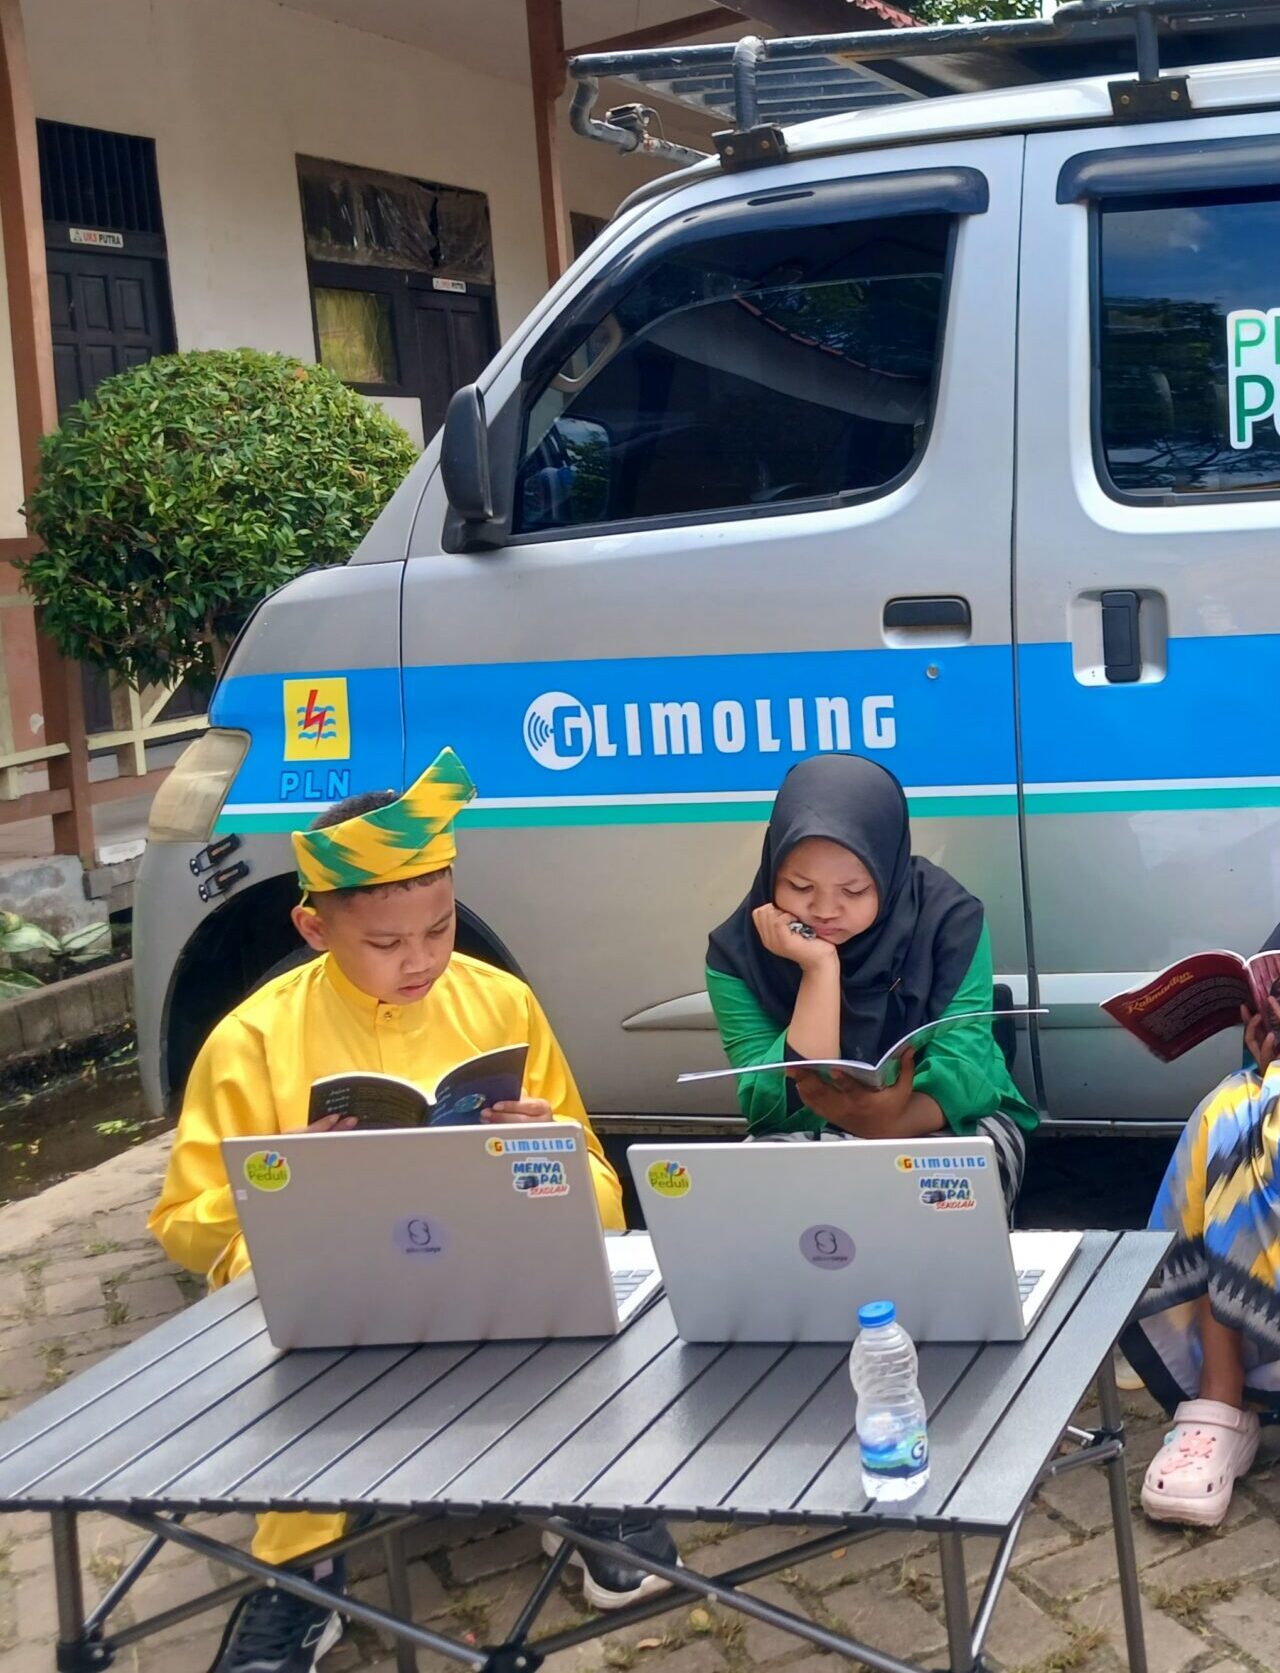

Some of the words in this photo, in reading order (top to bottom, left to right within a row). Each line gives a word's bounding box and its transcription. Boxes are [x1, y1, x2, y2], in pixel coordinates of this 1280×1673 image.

[551, 695, 897, 758] GLIMOLING
[280, 769, 351, 800] PLN
[494, 1139, 575, 1152] GLIMOLING
[513, 1162, 562, 1174] MENYA
[903, 1156, 986, 1169] GLIMOLING
[540, 1173, 563, 1185] PA!
[920, 1178, 969, 1189] MENYA
[947, 1189, 971, 1200] PA!
